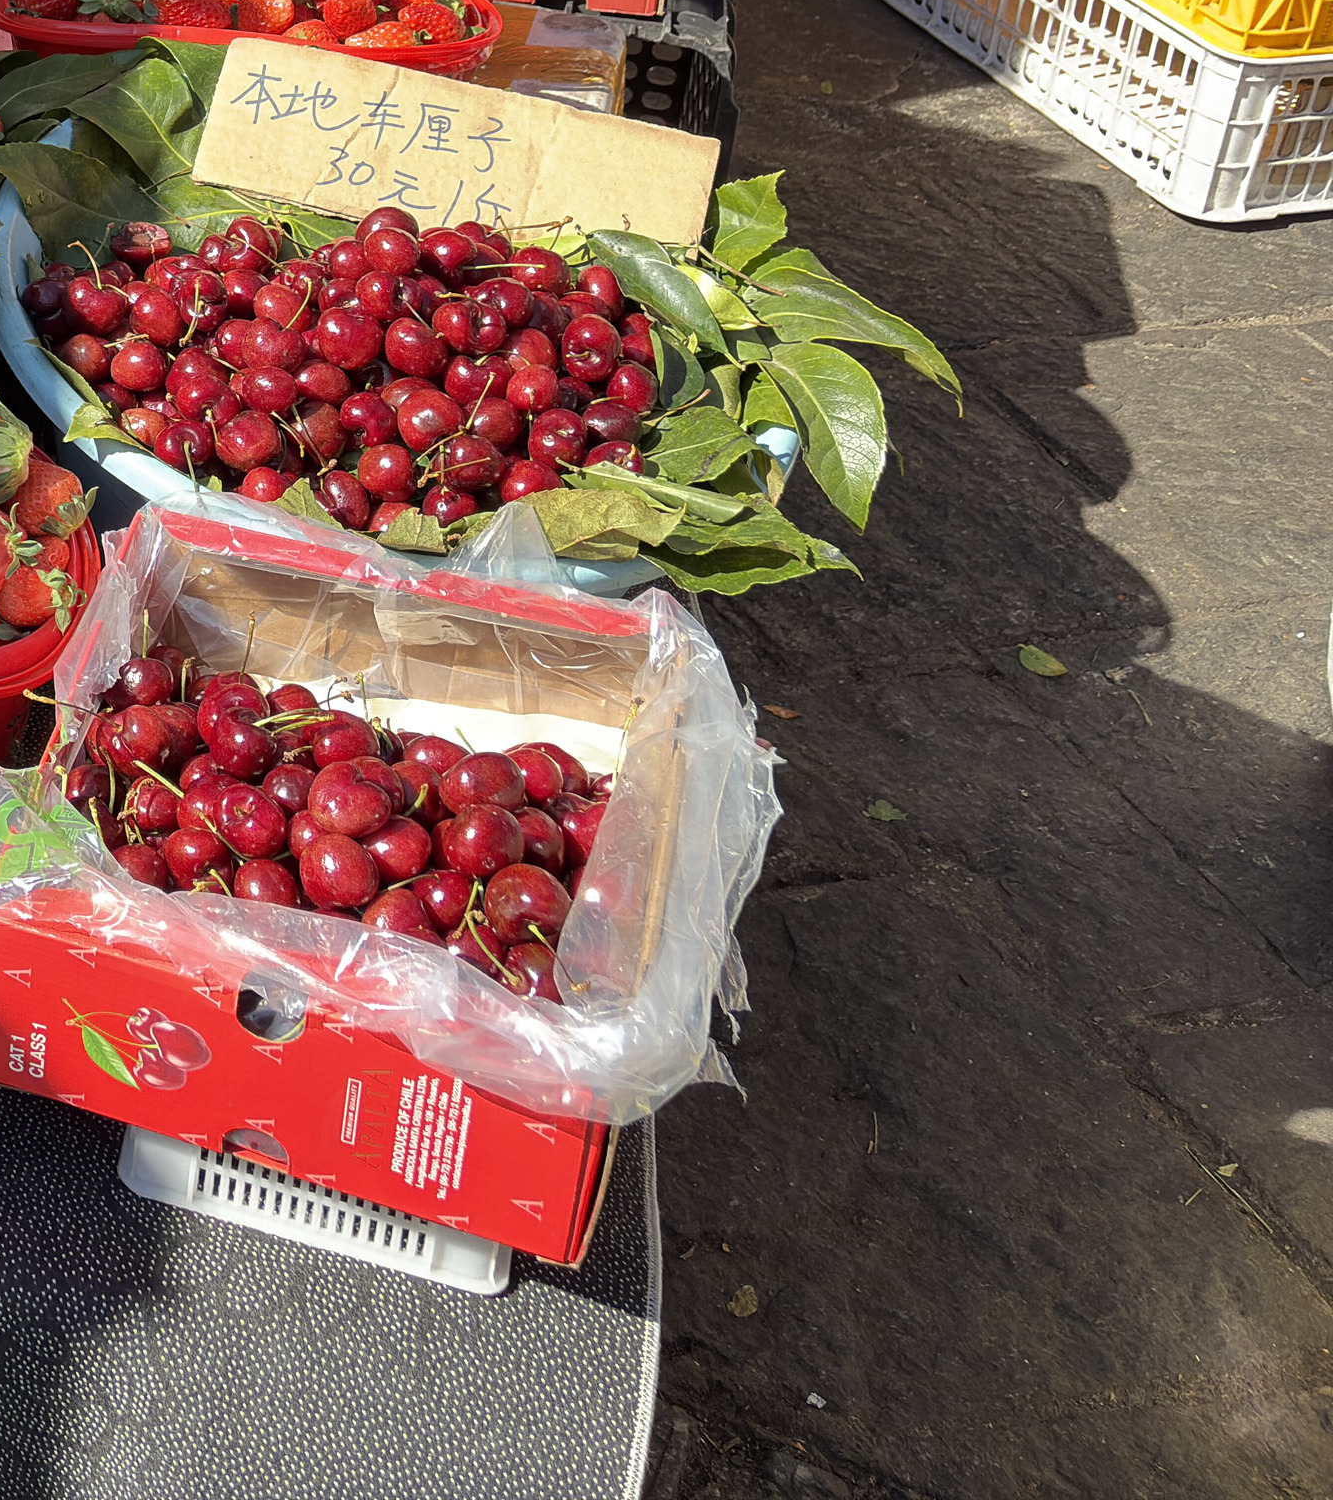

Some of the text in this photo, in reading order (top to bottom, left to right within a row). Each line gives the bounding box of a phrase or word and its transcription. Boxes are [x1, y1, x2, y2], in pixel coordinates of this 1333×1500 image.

[230, 63, 512, 172] 本地车厘子
[316, 146, 512, 228] 30元1斤
[8, 1034, 26, 1073] CAT 1
[28, 1022, 47, 1078] CLASS 1
[345, 1084, 358, 1140] PREMIUM QUALITY
[350, 1068, 392, 1172] APALTA
[390, 1077, 415, 1174] PRODUCE OF CHILE
[404, 1074, 428, 1186] AGRICOLA SANTA CRISTINA LTDA.
[438, 1092, 449, 1110] Chile
